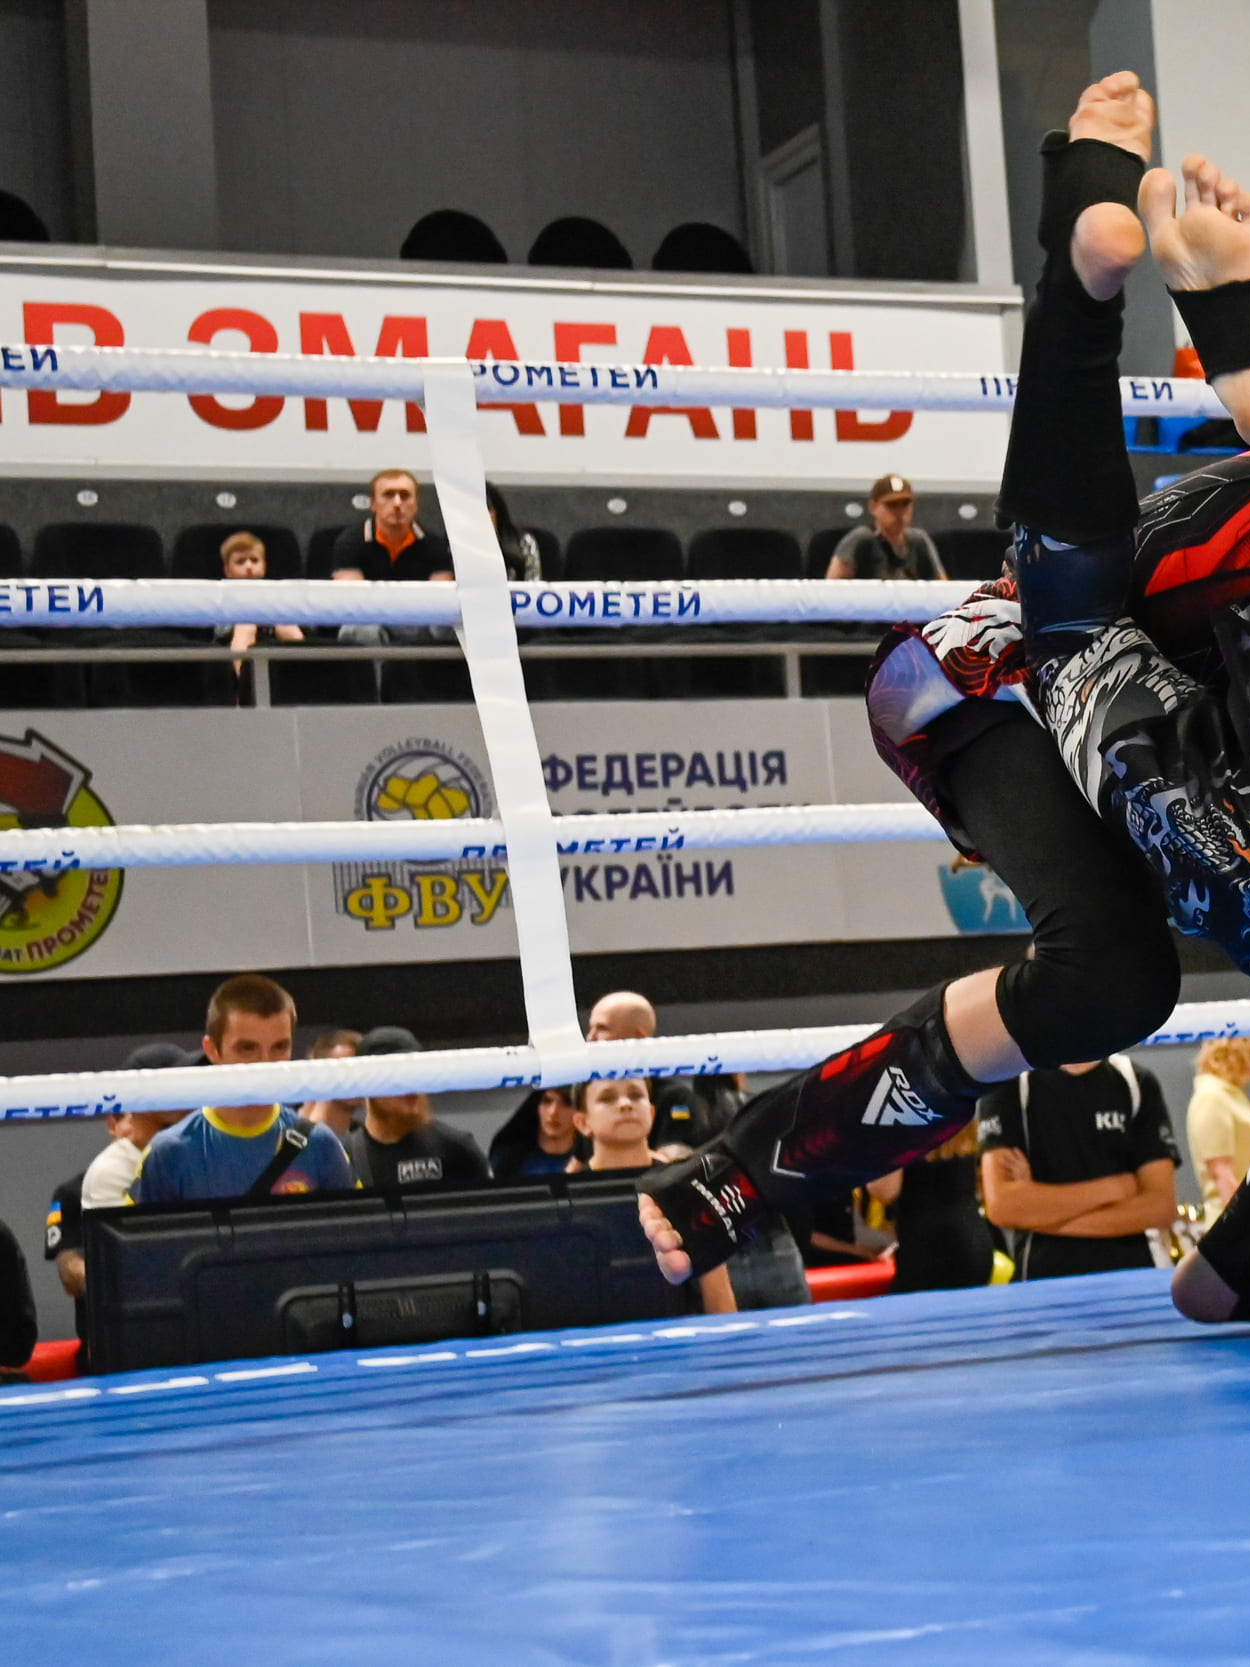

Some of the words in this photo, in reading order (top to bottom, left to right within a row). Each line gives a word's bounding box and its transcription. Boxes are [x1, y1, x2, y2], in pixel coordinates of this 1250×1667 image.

[23, 302, 131, 426] В
[187, 307, 913, 442] ЗМАГАНЬ
[509, 585, 700, 617] РОМЕТЕЙ
[541, 749, 788, 797] ФЕДЕРАЦІЯ
[344, 869, 510, 932] ФВУ
[887, 1066, 945, 1121] RDX
